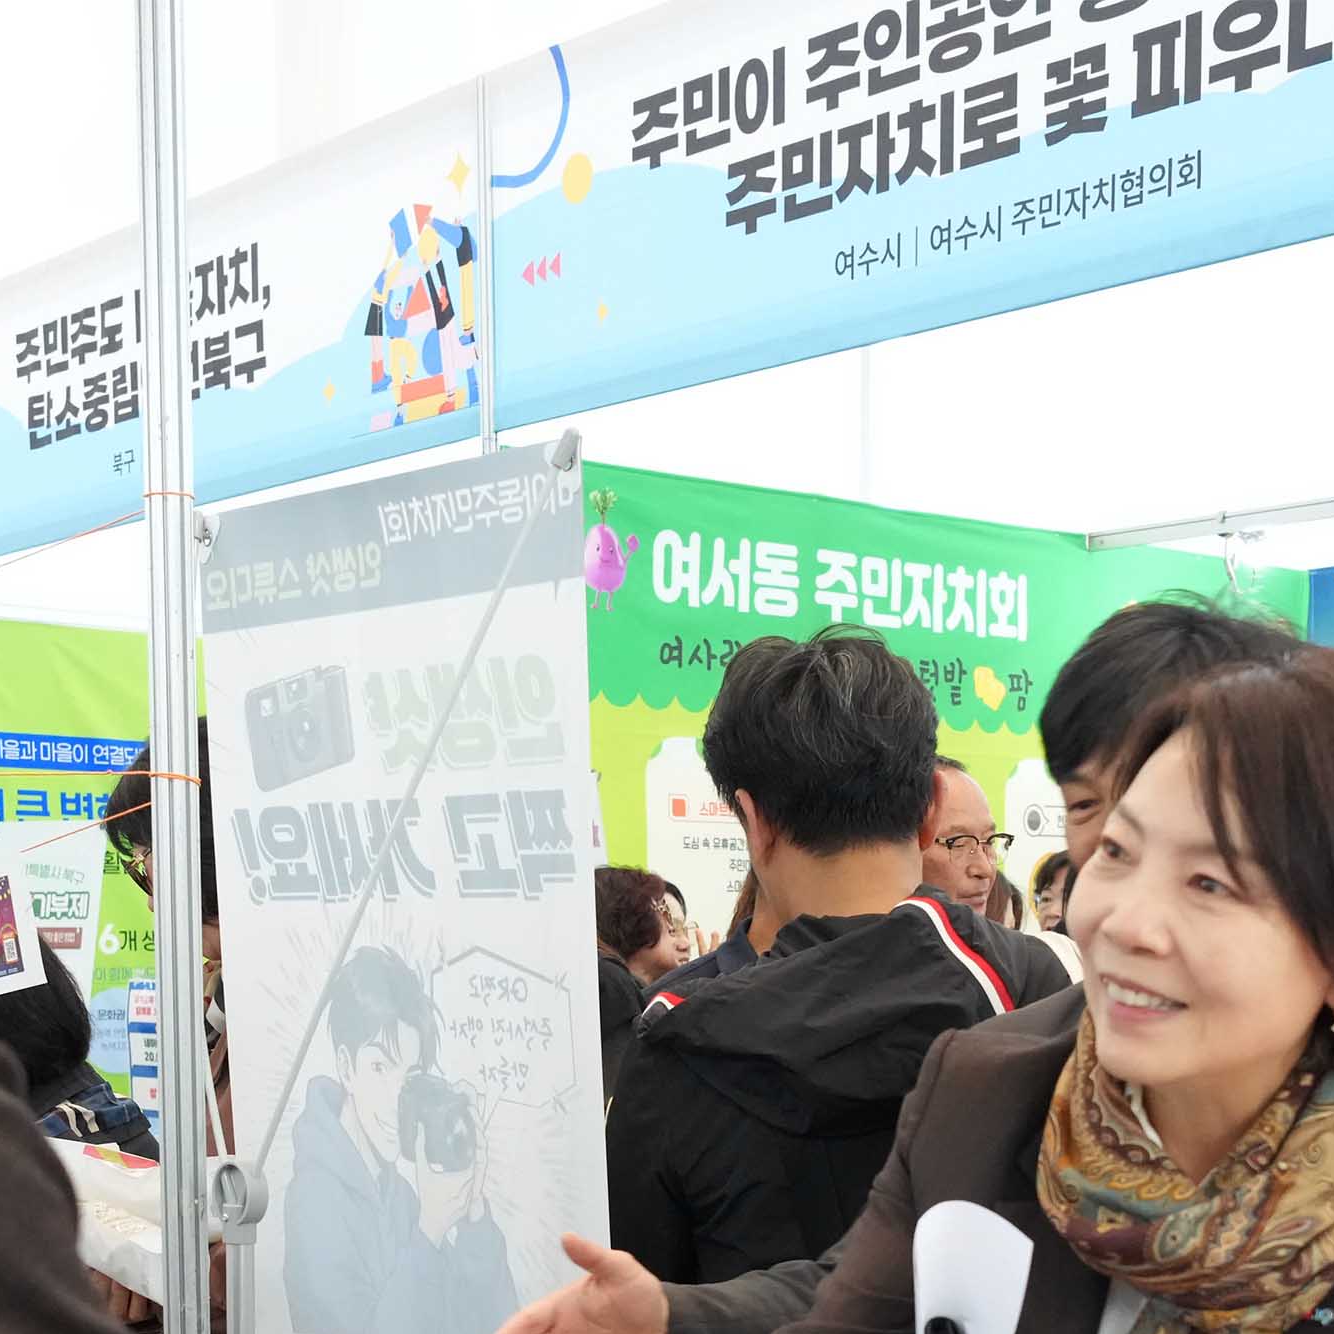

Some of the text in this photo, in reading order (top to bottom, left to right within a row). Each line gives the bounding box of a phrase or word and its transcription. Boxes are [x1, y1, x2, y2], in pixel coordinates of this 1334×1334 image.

[631, 0, 1052, 170] 주민이 주인공인
[724, 72, 1022, 237] 주민자치로
[1043, 43, 1110, 147] 꽃
[833, 148, 1204, 283] 여수시 여수시 주민자치협의회
[15, 295, 124, 384] 주민주도
[27, 360, 140, 450] 탄소중립
[112, 448, 136, 477] 북구
[651, 529, 1028, 642] 여서동 주민자치회
[40, 740, 88, 764] 마을이
